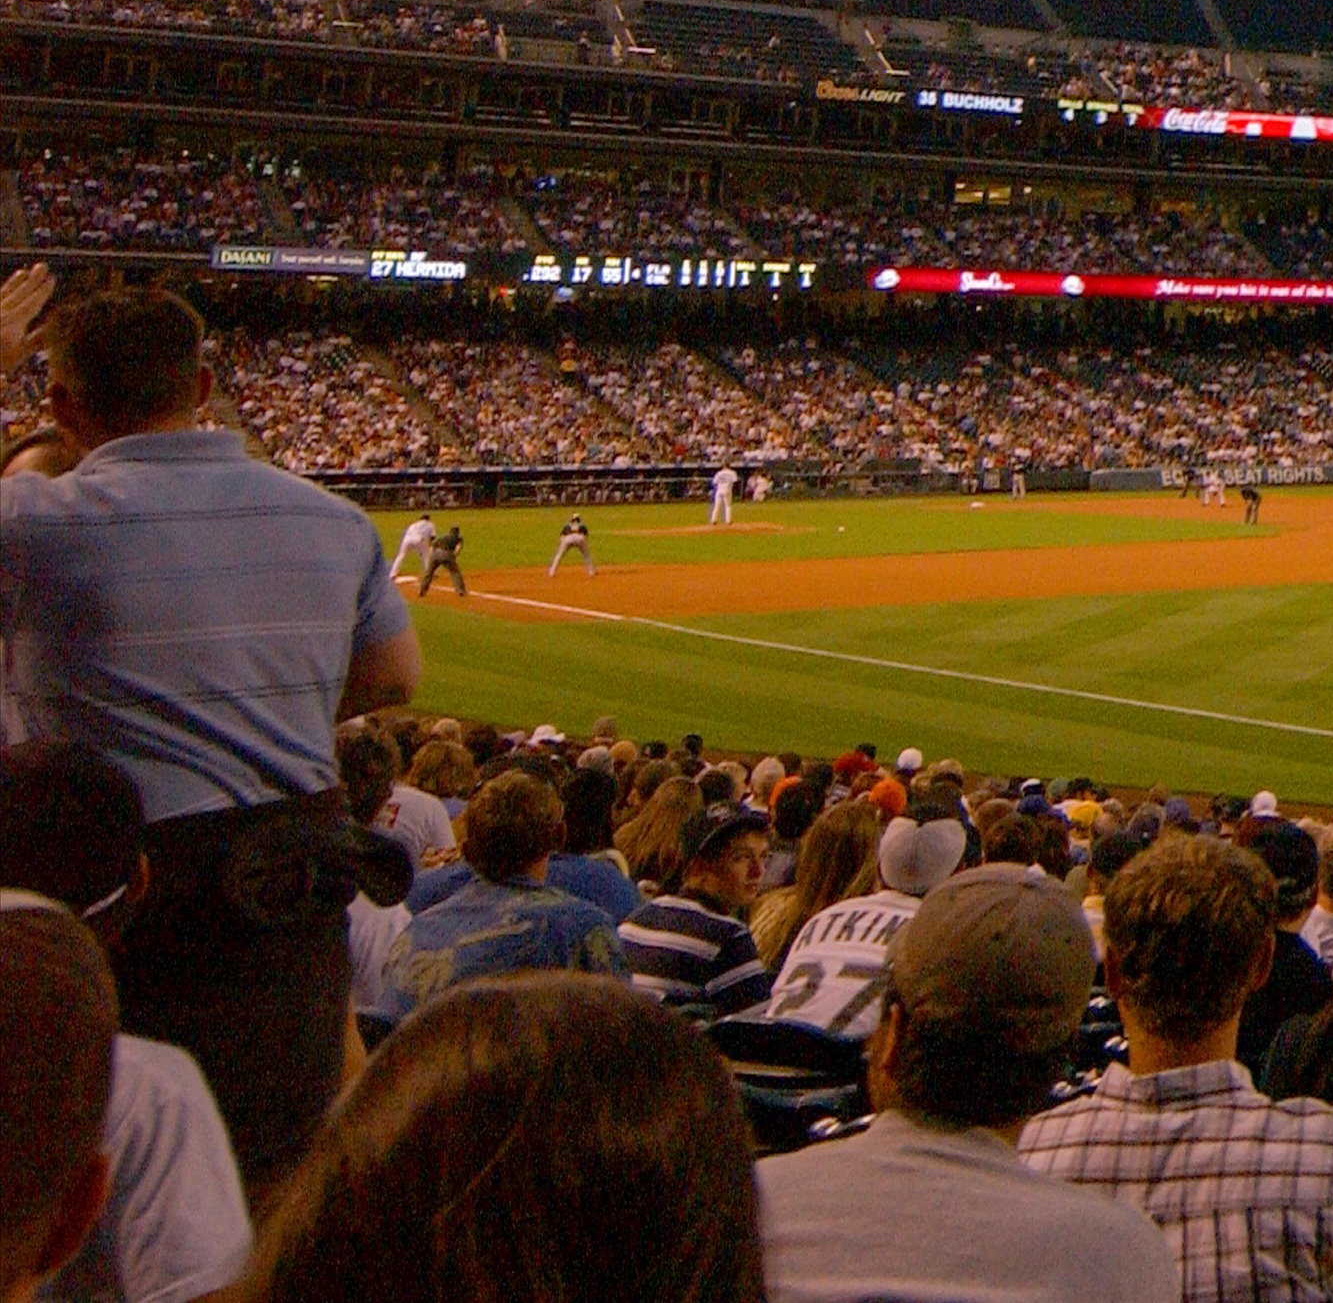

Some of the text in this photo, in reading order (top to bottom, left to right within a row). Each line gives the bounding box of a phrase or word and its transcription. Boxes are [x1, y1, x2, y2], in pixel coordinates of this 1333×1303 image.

[860, 88, 907, 104] LIGHT
[942, 91, 1024, 113] BUCHHOLZ
[220, 249, 271, 264] DASANI
[370, 260, 467, 279] 27 HERMIDA
[571, 266, 593, 284] 17
[1216, 285, 1239, 300] you
[1306, 284, 1325, 298] the
[1224, 467, 1264, 485] SEAT
[772, 960, 893, 1034] 27
